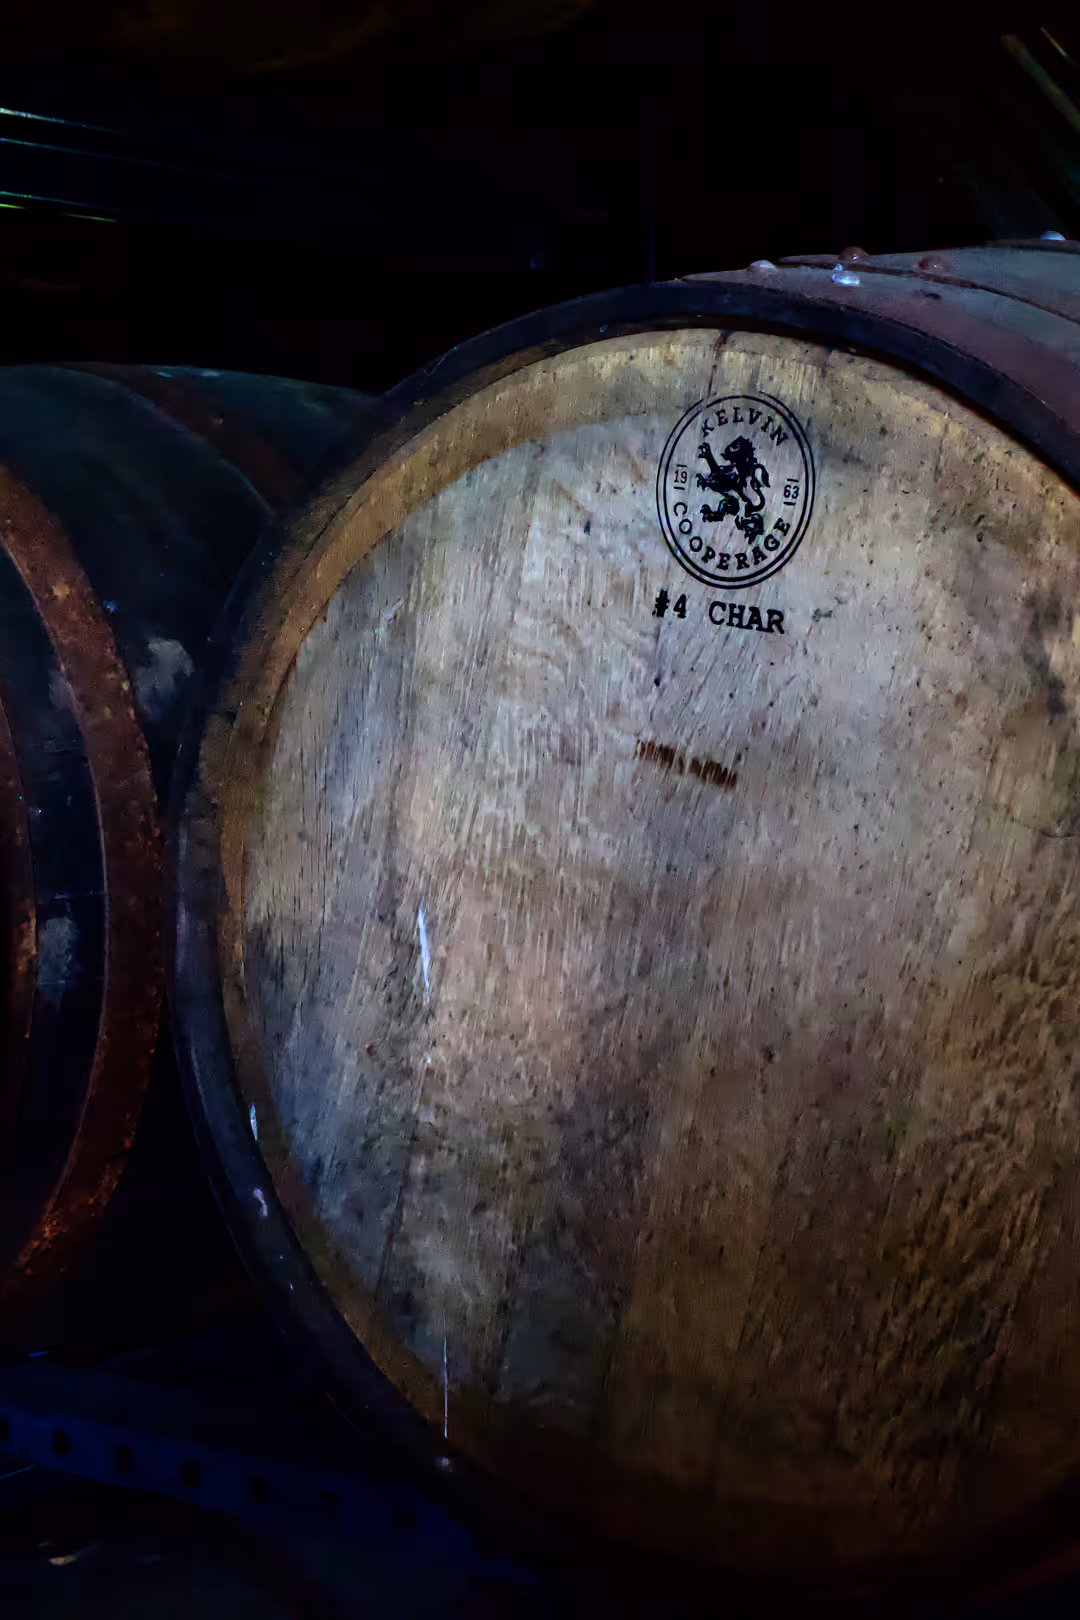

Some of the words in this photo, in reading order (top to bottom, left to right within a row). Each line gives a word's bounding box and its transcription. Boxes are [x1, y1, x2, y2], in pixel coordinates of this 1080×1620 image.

[701, 407, 788, 446] KELVIN
[674, 470, 688, 484] 19
[783, 484, 800, 499] 63
[673, 502, 791, 570] COOPERAGE
[655, 589, 687, 619] #4
[708, 601, 785, 634] CHAR
